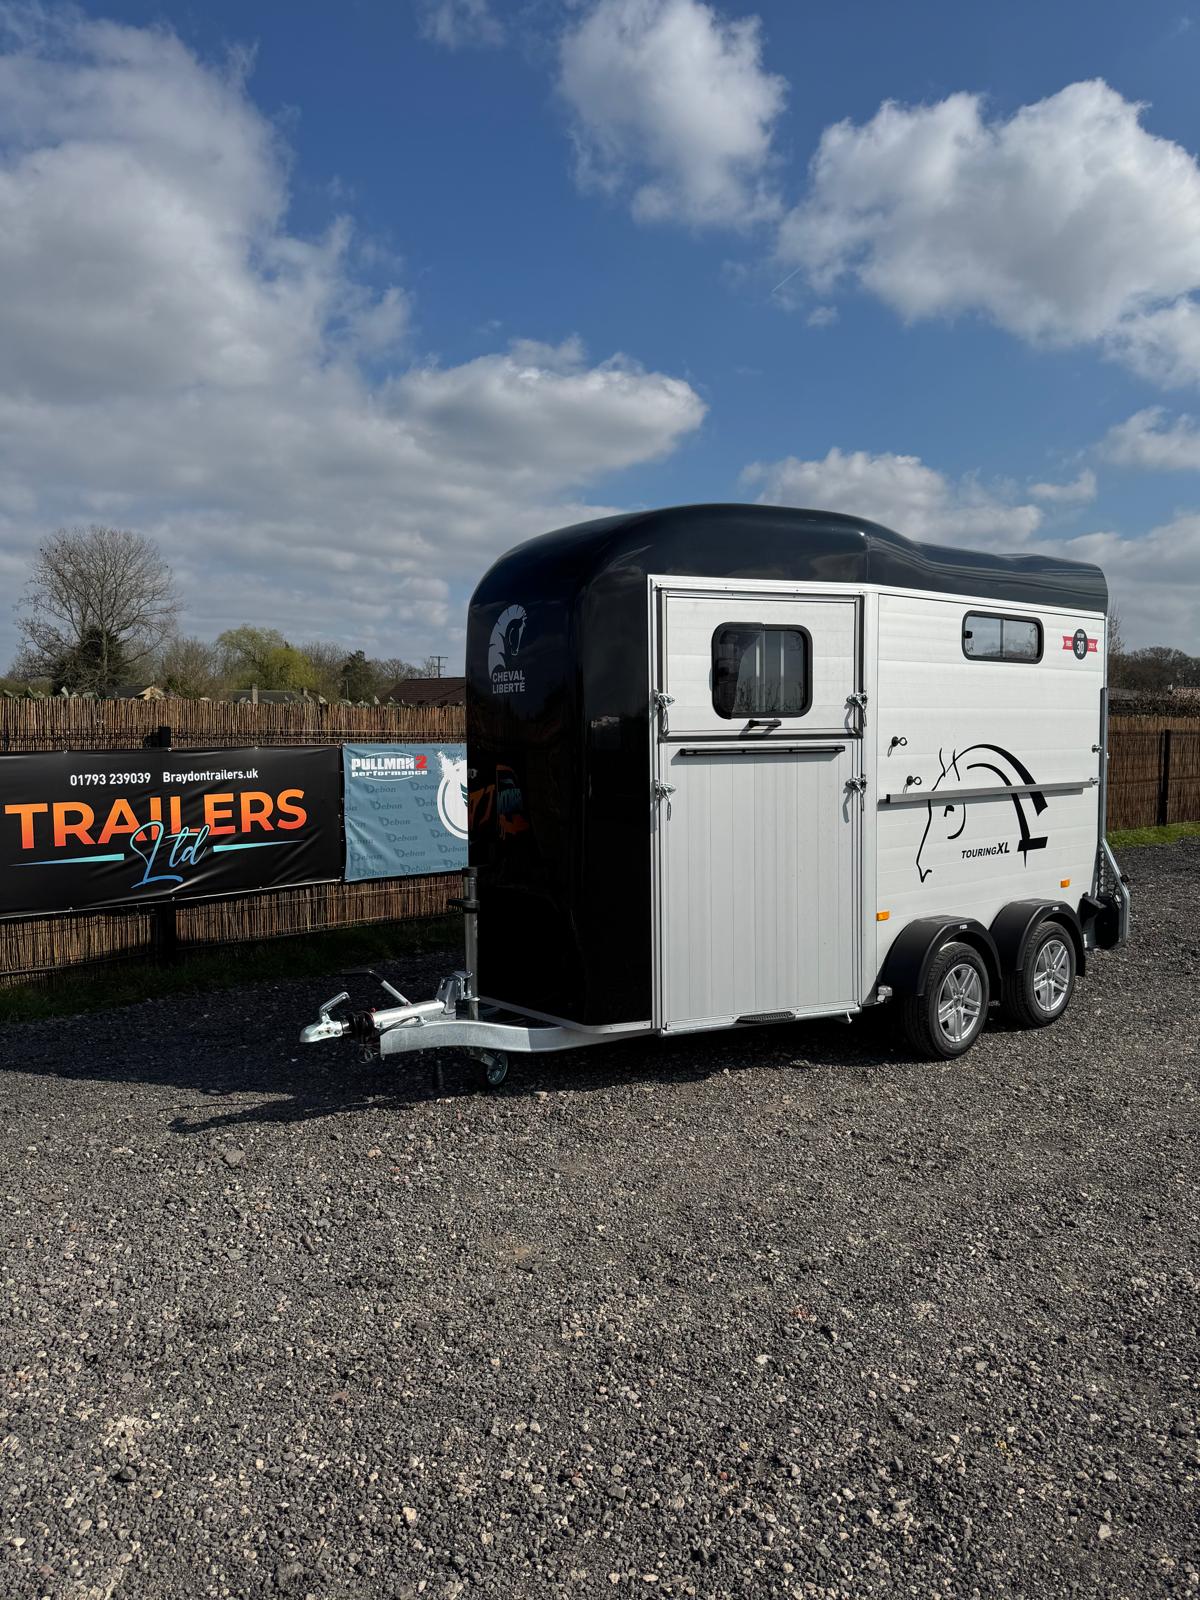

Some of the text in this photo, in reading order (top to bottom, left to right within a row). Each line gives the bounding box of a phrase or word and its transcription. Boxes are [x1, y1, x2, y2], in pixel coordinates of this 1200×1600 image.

[492, 670, 525, 682] CHEVAL
[492, 680, 525, 694] LIBERTÉ
[70, 768, 259, 786] 01793 239039 Braydontrailers.uk
[351, 770, 428, 778] performance
[4, 788, 308, 850] TRAILERS
[130, 820, 211, 889] Ltd
